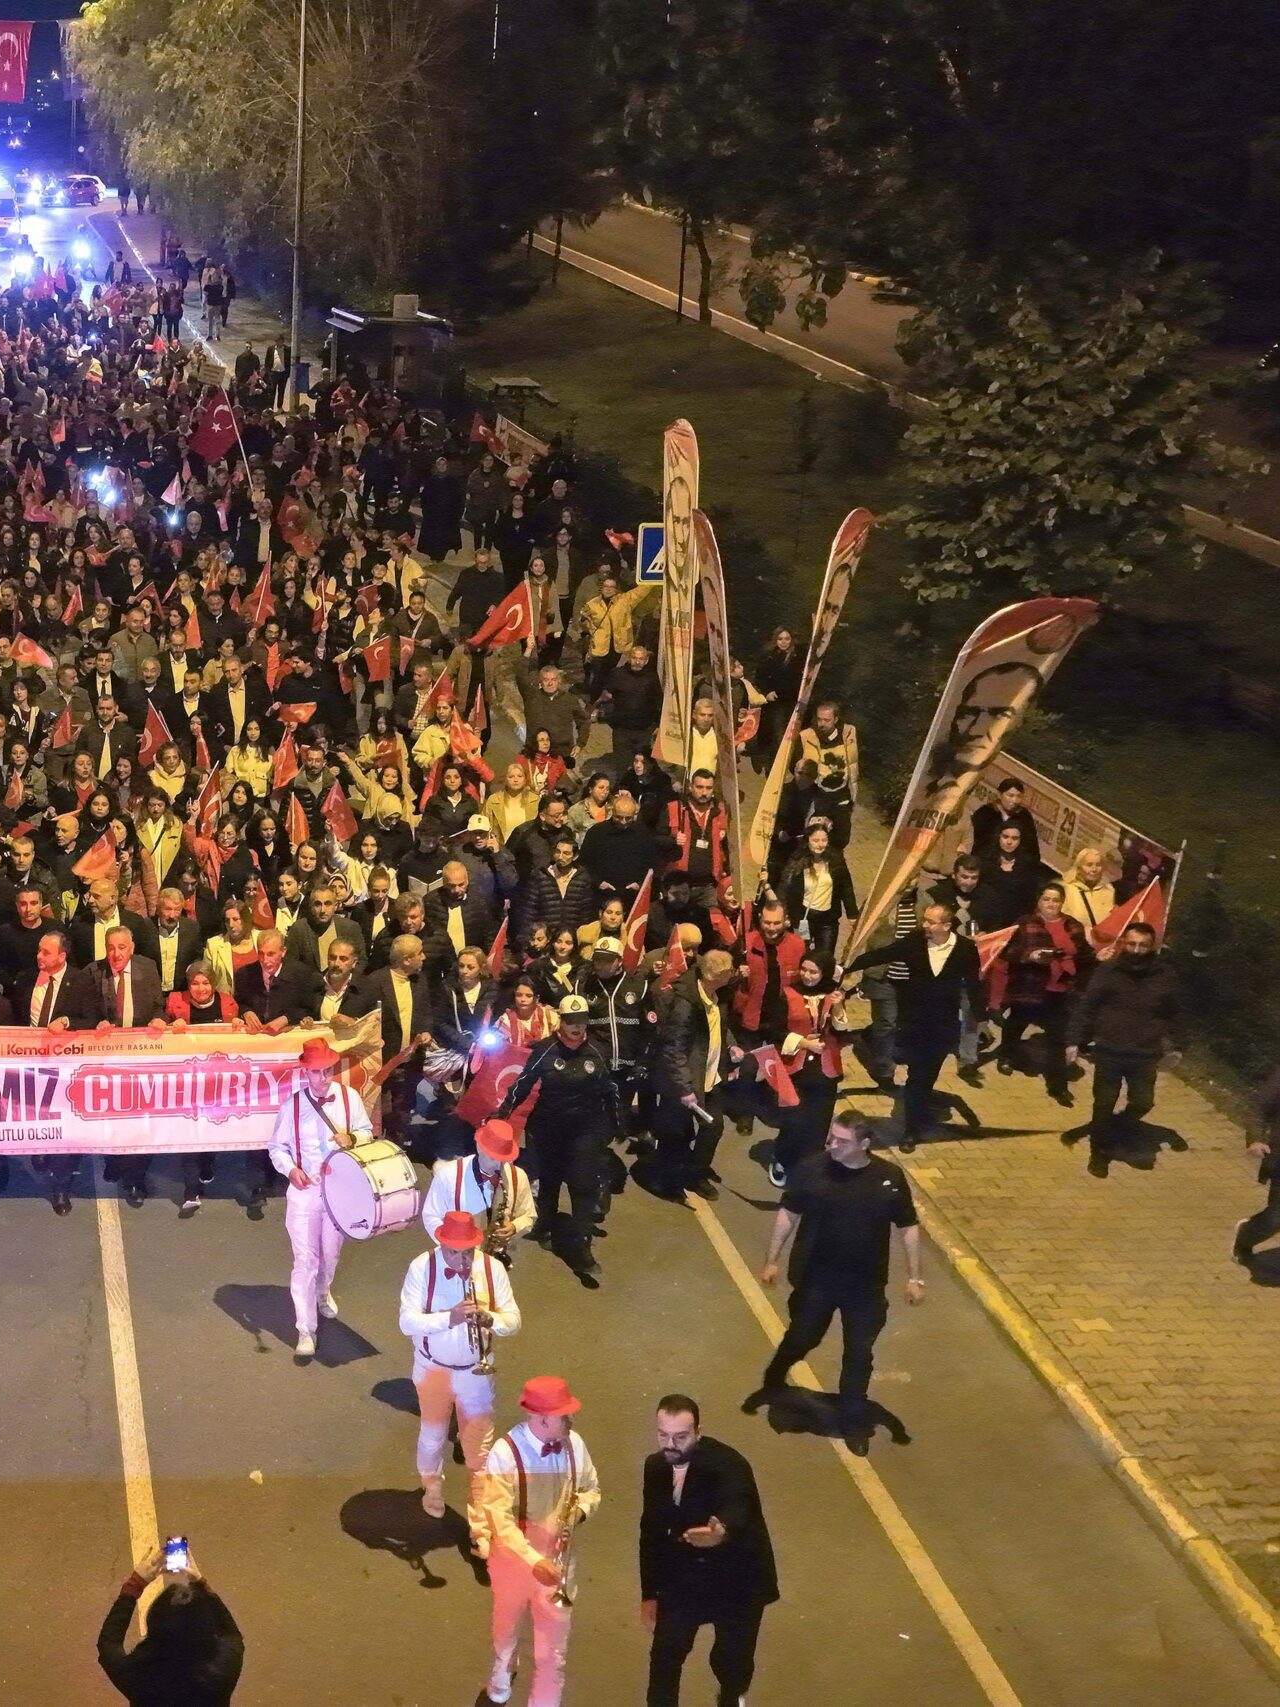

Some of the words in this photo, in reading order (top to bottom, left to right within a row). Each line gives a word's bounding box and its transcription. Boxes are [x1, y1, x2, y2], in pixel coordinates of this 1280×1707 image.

[7, 1044, 50, 1056] Kemal
[53, 1044, 84, 1056] Çebi
[28, 1127, 63, 1141] OLSUN
